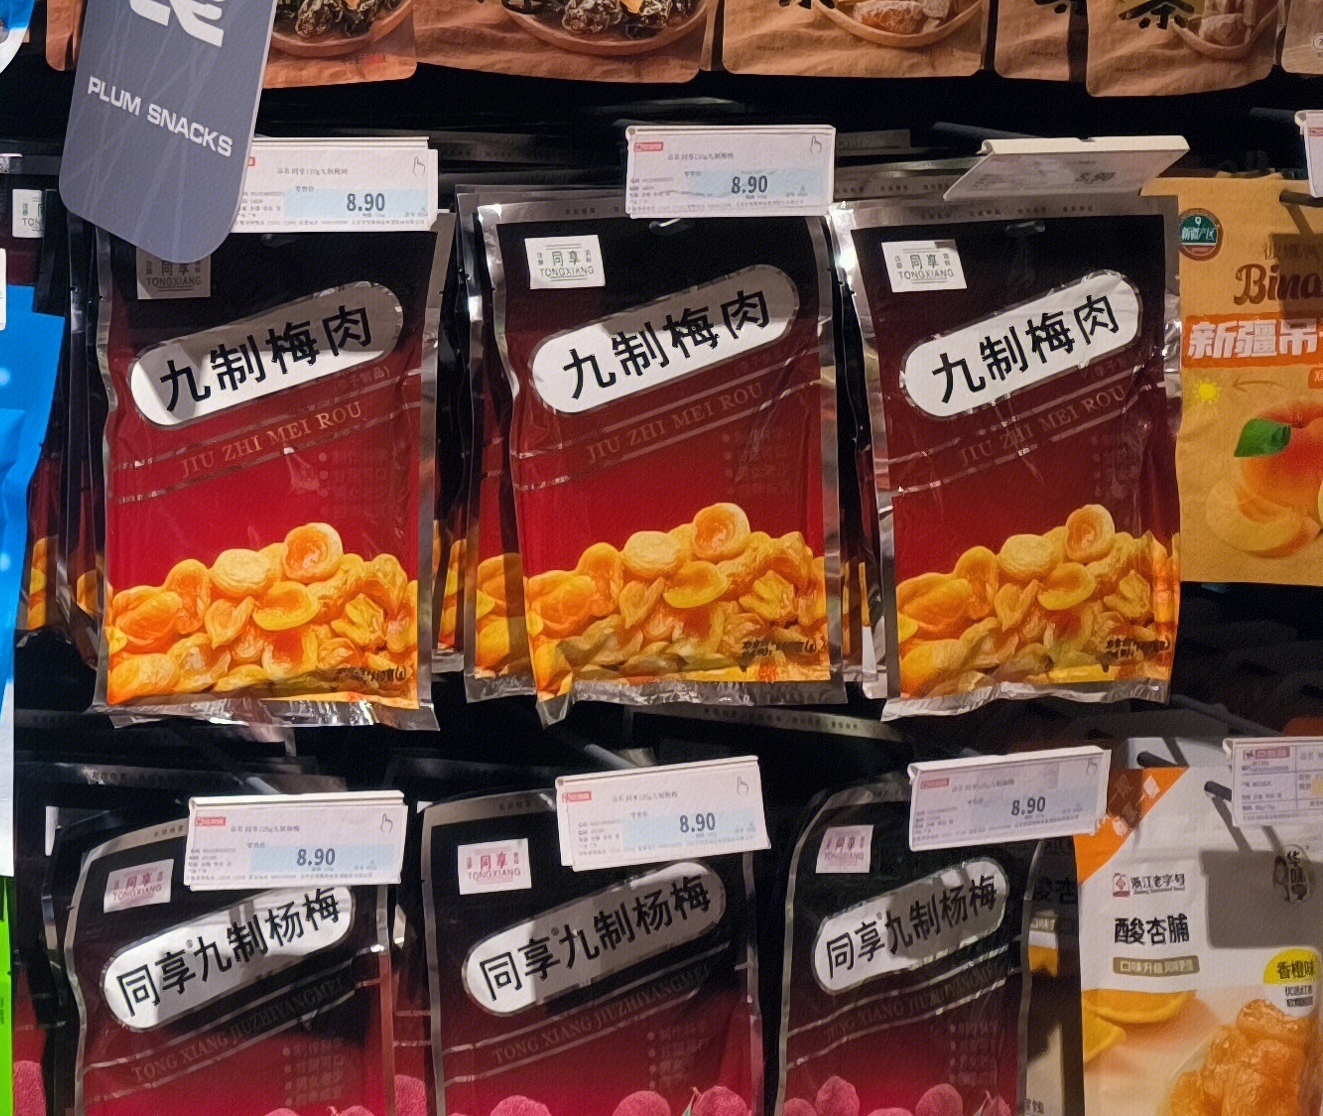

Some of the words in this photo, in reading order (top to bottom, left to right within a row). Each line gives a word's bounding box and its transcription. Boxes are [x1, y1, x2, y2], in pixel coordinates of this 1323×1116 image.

[87, 74, 142, 117] PLUM
[146, 102, 234, 157] SNACKS
[731, 174, 769, 196] 8.90
[346, 192, 386, 213] 8.90
[144, 273, 204, 288] TONGXIANG
[538, 265, 596, 278] TONGXIANG
[896, 268, 956, 282] TONGXIANG
[561, 288, 772, 401] 九制梅肉
[930, 291, 1122, 405] 九制梅肉
[158, 302, 375, 414] 九制梅肉
[584, 438, 622, 466] JIU
[628, 419, 668, 448] ZHI
[670, 404, 716, 433] MEI
[719, 382, 765, 413] ROU
[1039, 404, 1080, 437] MEI
[181, 451, 216, 479] JIU
[222, 434, 262, 462] ZHI
[265, 419, 313, 447] MEI
[314, 400, 365, 431] ROU
[1011, 796, 1047, 817] 8.90
[679, 812, 718, 834] 8.90
[296, 848, 337, 868] 8.90
[466, 867, 523, 884] TONGXIANG
[110, 883, 171, 902] TONGXIANG
[1113, 913, 1191, 946] 酸杏脯
